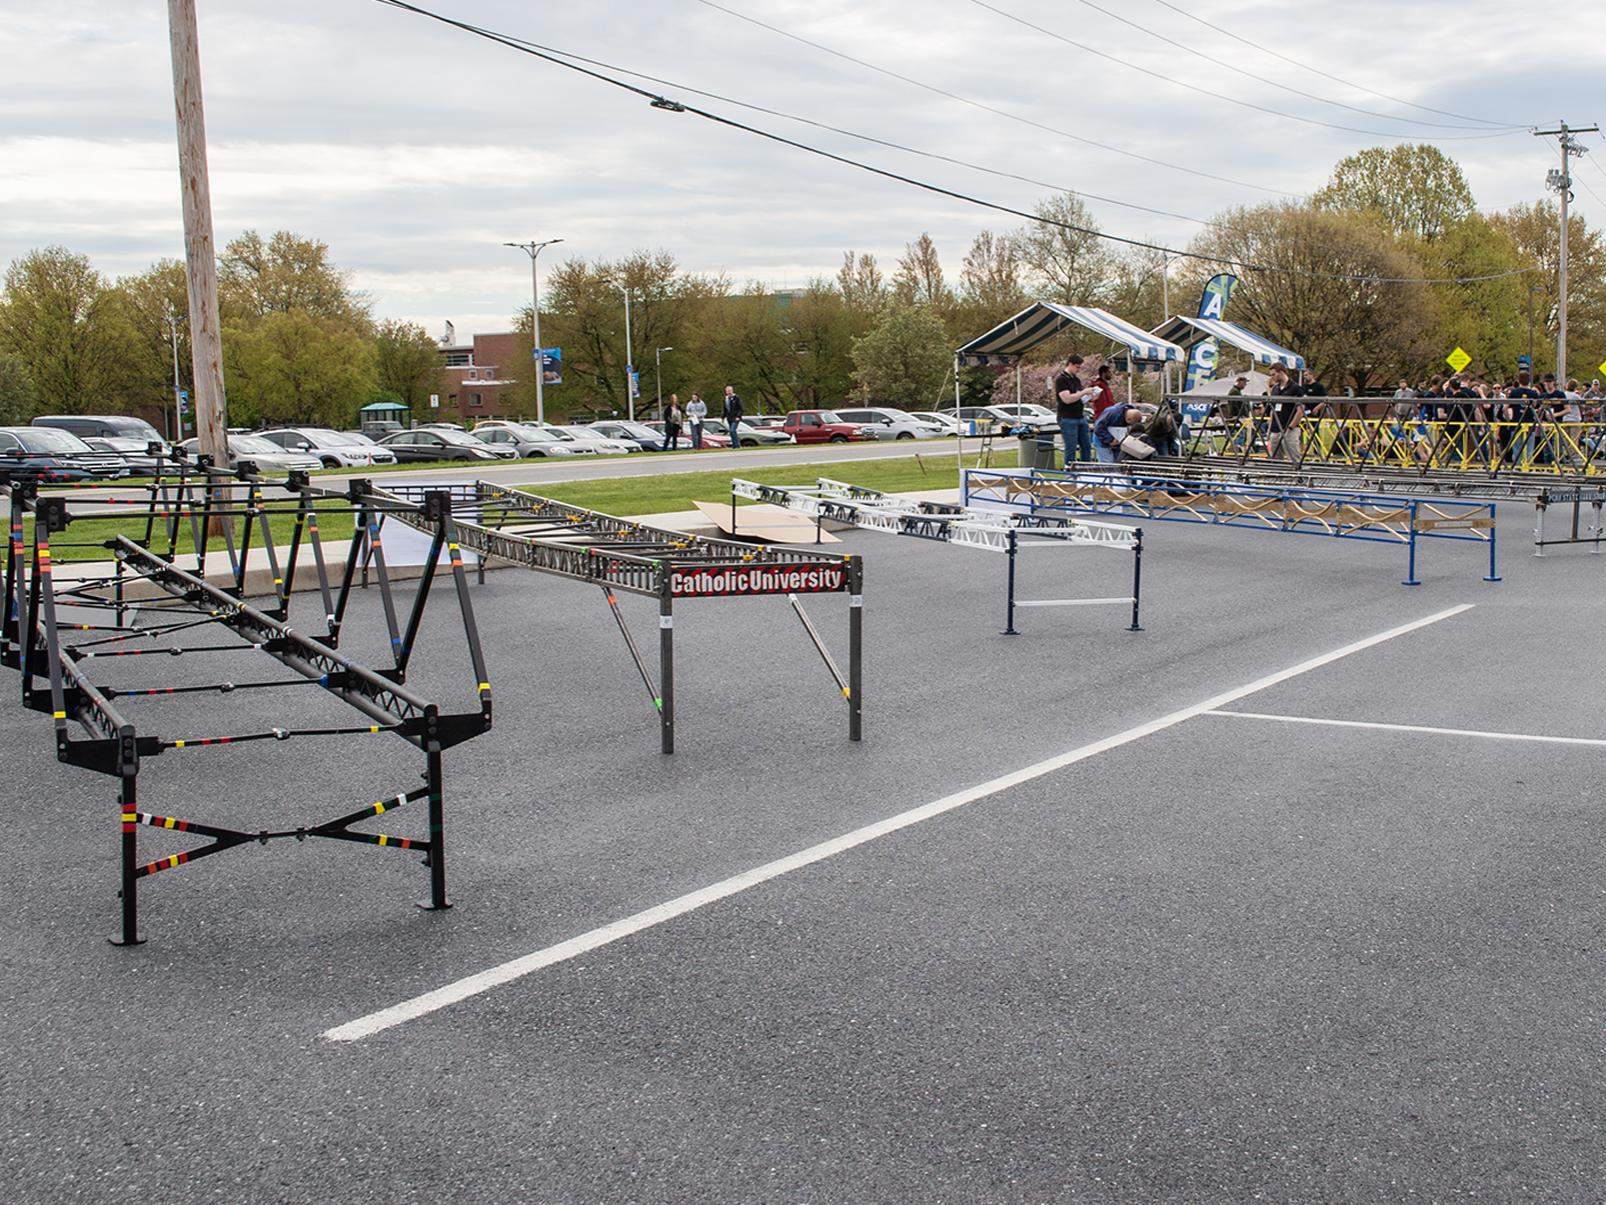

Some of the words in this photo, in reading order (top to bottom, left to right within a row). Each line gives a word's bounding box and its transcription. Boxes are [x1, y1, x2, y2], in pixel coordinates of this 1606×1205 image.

[1191, 293, 1221, 389] ACE
[671, 571, 748, 593] Catholic
[750, 569, 841, 591] University
